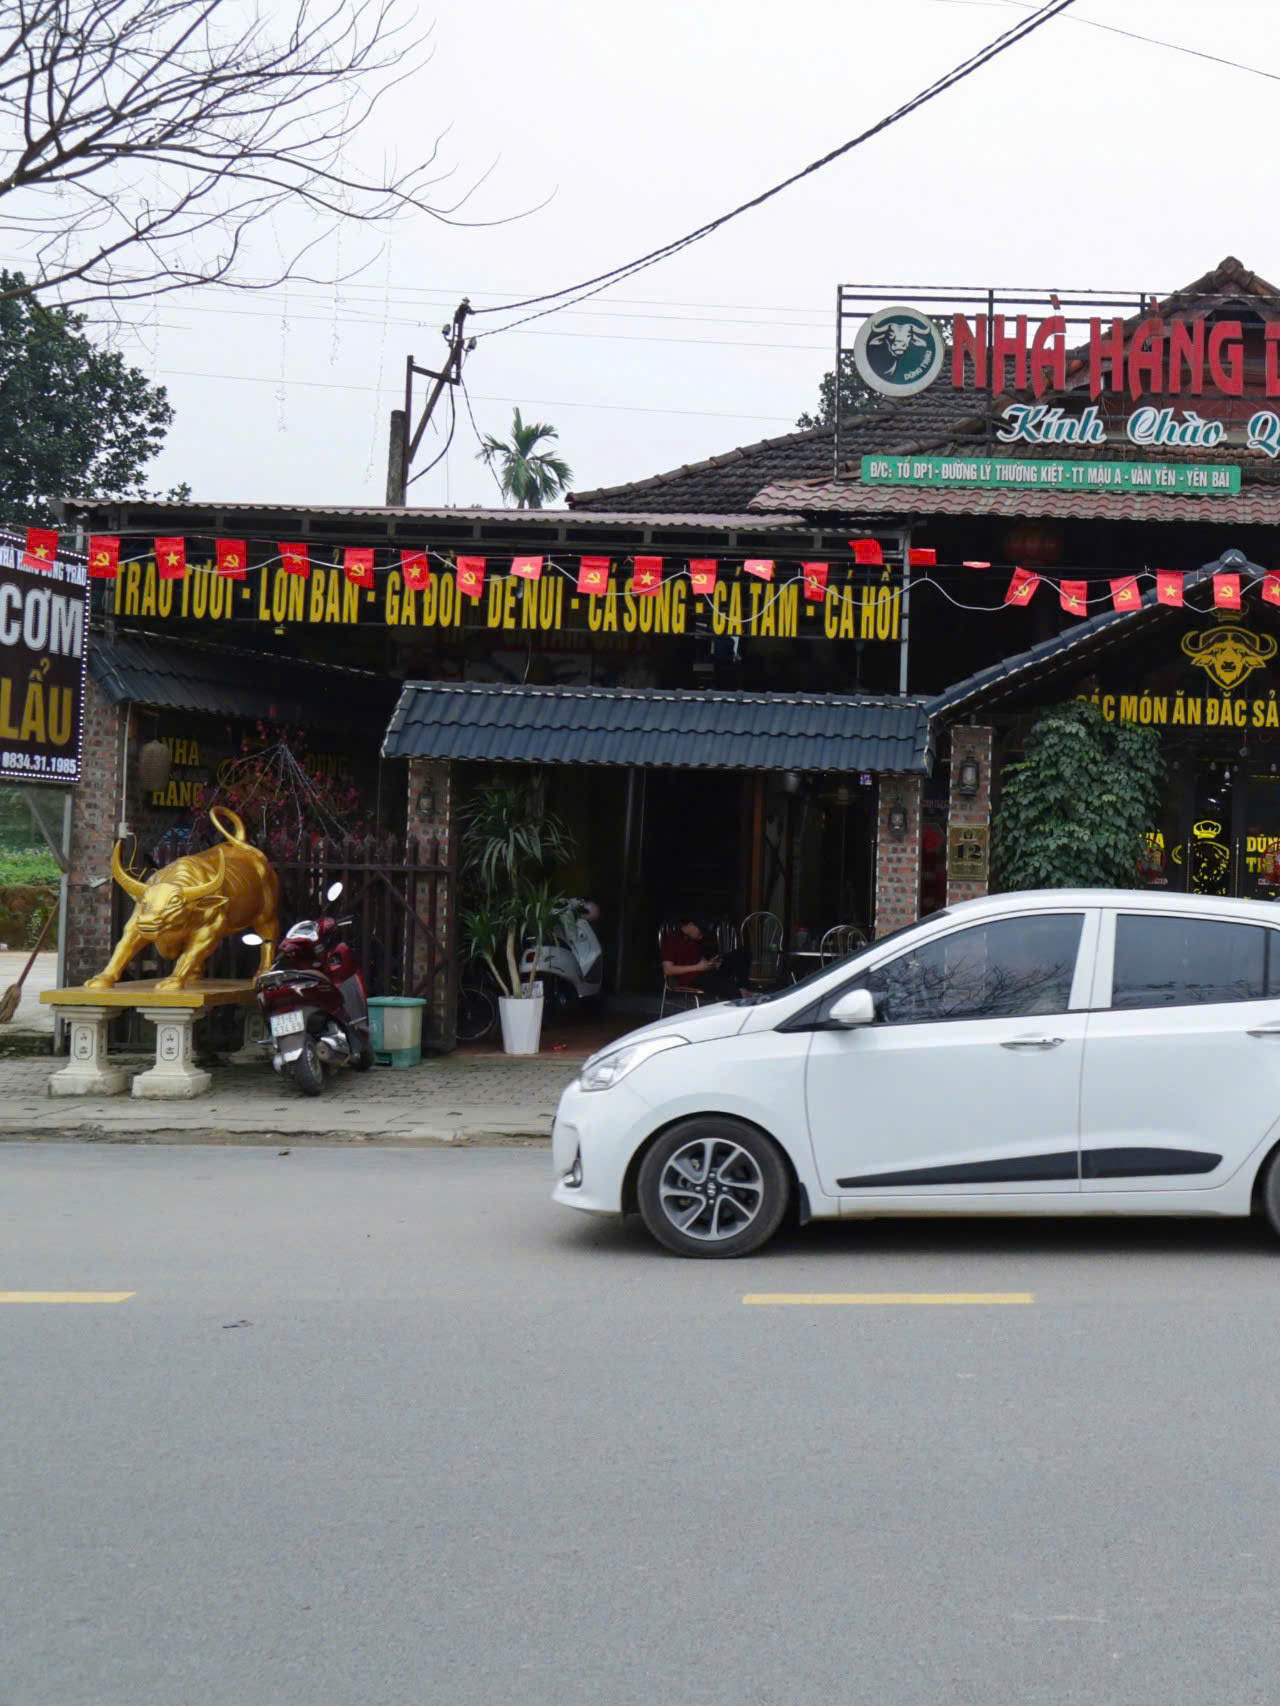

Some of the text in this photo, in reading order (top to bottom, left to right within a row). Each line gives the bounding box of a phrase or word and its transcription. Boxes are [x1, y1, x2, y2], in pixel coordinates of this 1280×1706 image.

[952, 294, 1066, 400] NHÀ
[1090, 296, 1244, 400] HÀNG
[996, 403, 1107, 444] Kính
[1127, 406, 1227, 447] Chào
[913, 463, 932, 478] DP1
[941, 459, 977, 480] ĐƯỜNG
[980, 461, 991, 481] LÝ
[996, 463, 1036, 482] THƯỜNG
[1040, 463, 1063, 486] KIỆT
[1072, 467, 1085, 482] TT
[1114, 468, 1121, 483] A
[1131, 466, 1151, 485] VĂN
[1155, 466, 1176, 485] YÊN
[1186, 467, 1207, 487] YÊN
[0, 582, 84, 659] CƠM
[712, 566, 743, 635] CÁ
[825, 569, 855, 639] CÁ
[860, 564, 900, 640] HỒI
[0, 657, 73, 746] LẨU
[1120, 690, 1167, 724] MÓN
[1172, 690, 1201, 725] ĂN
